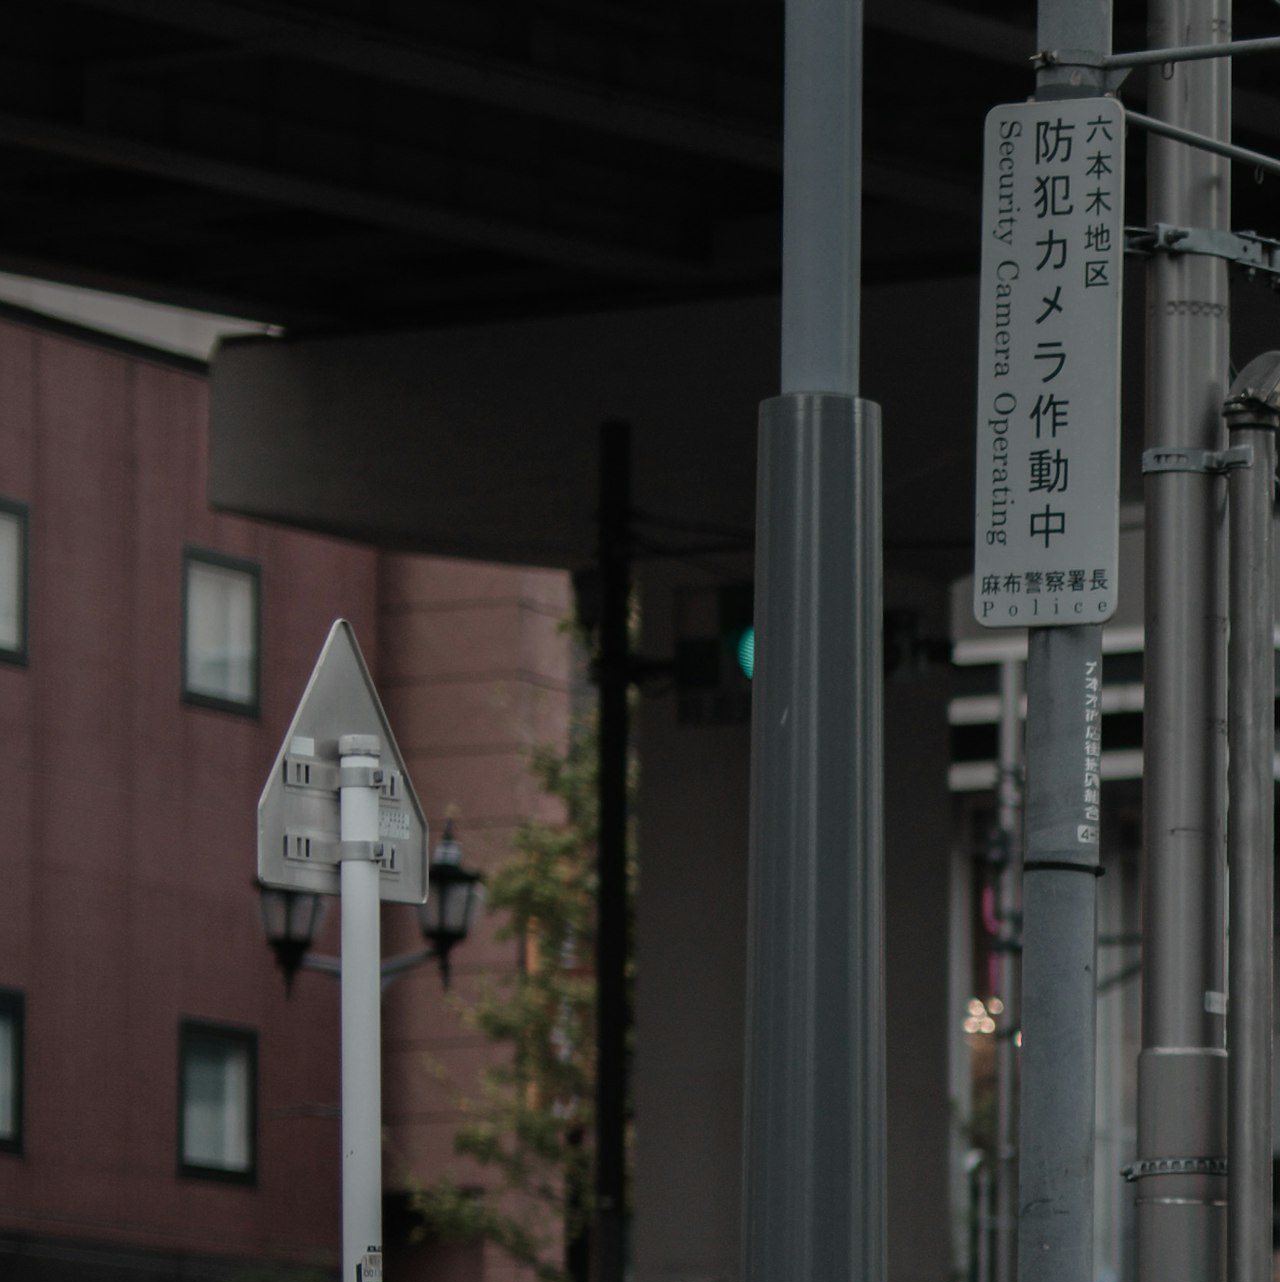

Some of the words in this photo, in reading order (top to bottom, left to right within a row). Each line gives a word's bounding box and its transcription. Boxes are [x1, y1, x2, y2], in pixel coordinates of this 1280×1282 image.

[993, 121, 1022, 245] Security
[1084, 116, 1113, 288] 六本木地区
[994, 260, 1020, 377] Camera
[1028, 118, 1075, 548] 防犯カメラ作動中
[986, 393, 1017, 546] Operating
[981, 569, 1108, 595] 麻布警察署長
[982, 598, 1107, 617] Police
